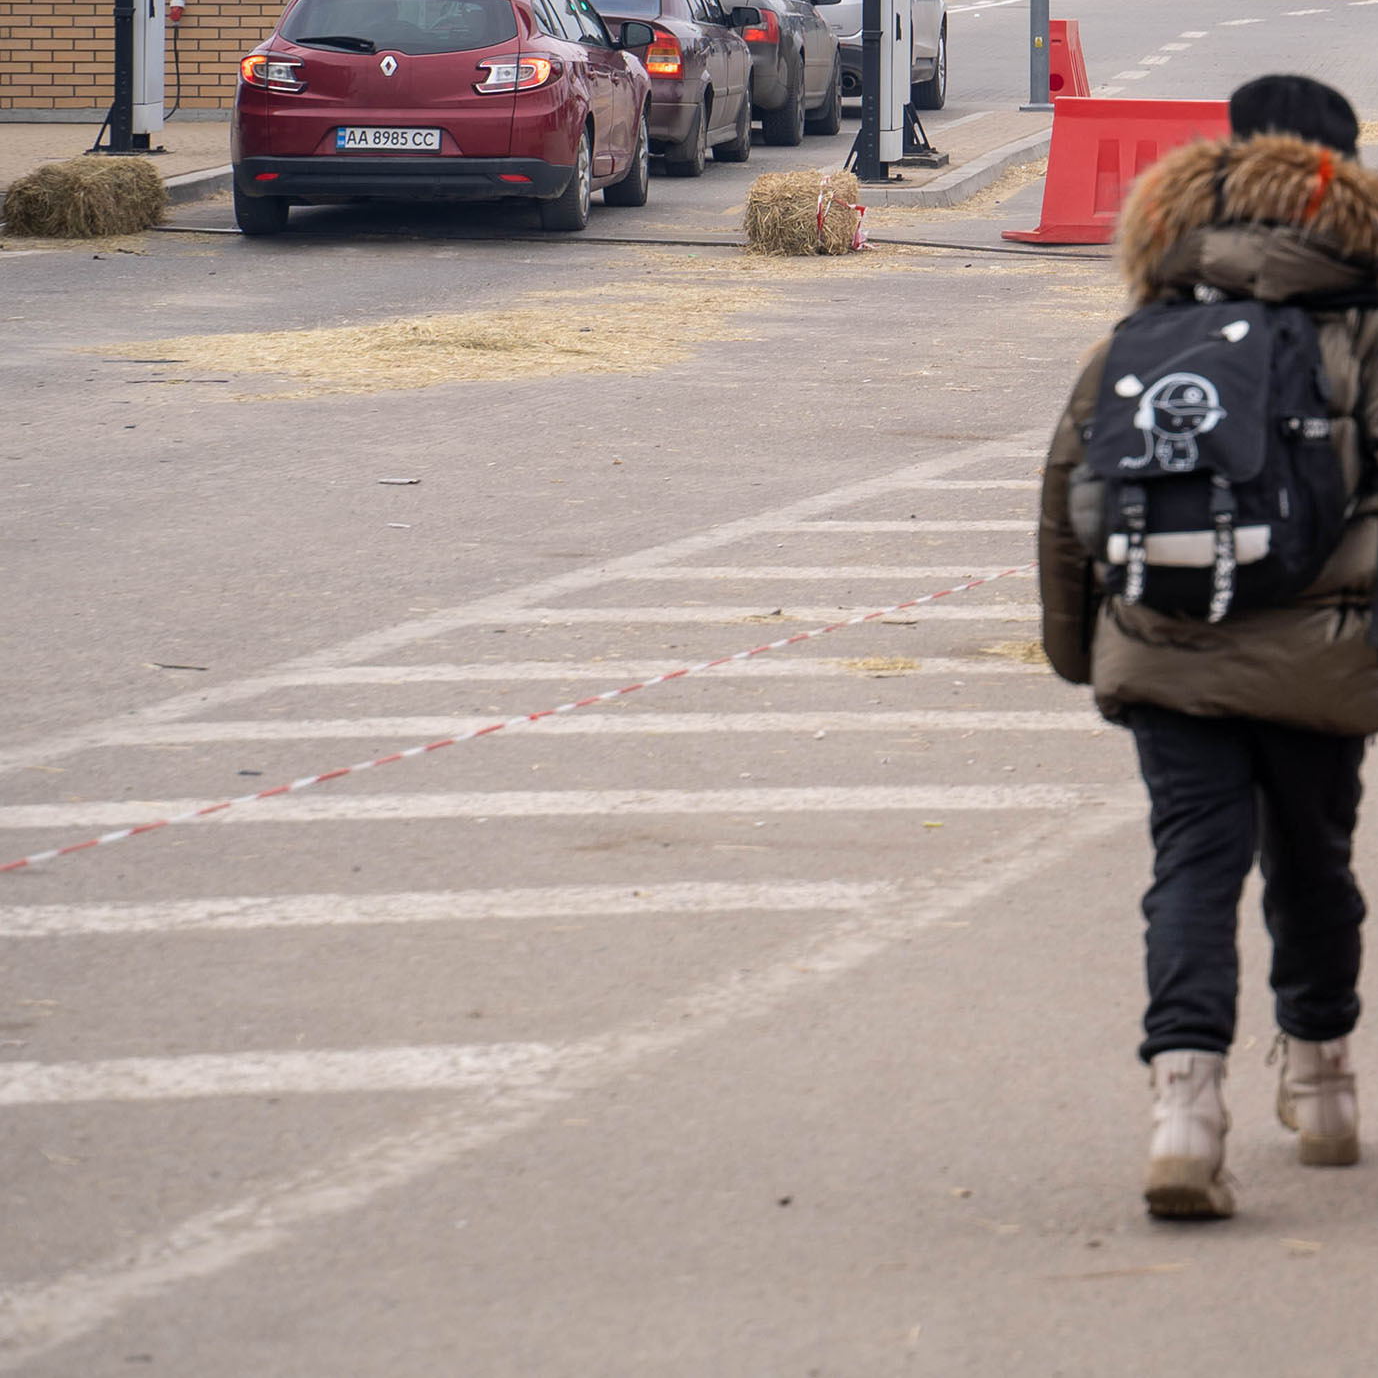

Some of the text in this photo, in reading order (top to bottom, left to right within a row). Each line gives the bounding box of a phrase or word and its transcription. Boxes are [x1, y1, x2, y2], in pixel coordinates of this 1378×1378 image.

[346, 130, 434, 147] AA 8985 CC
